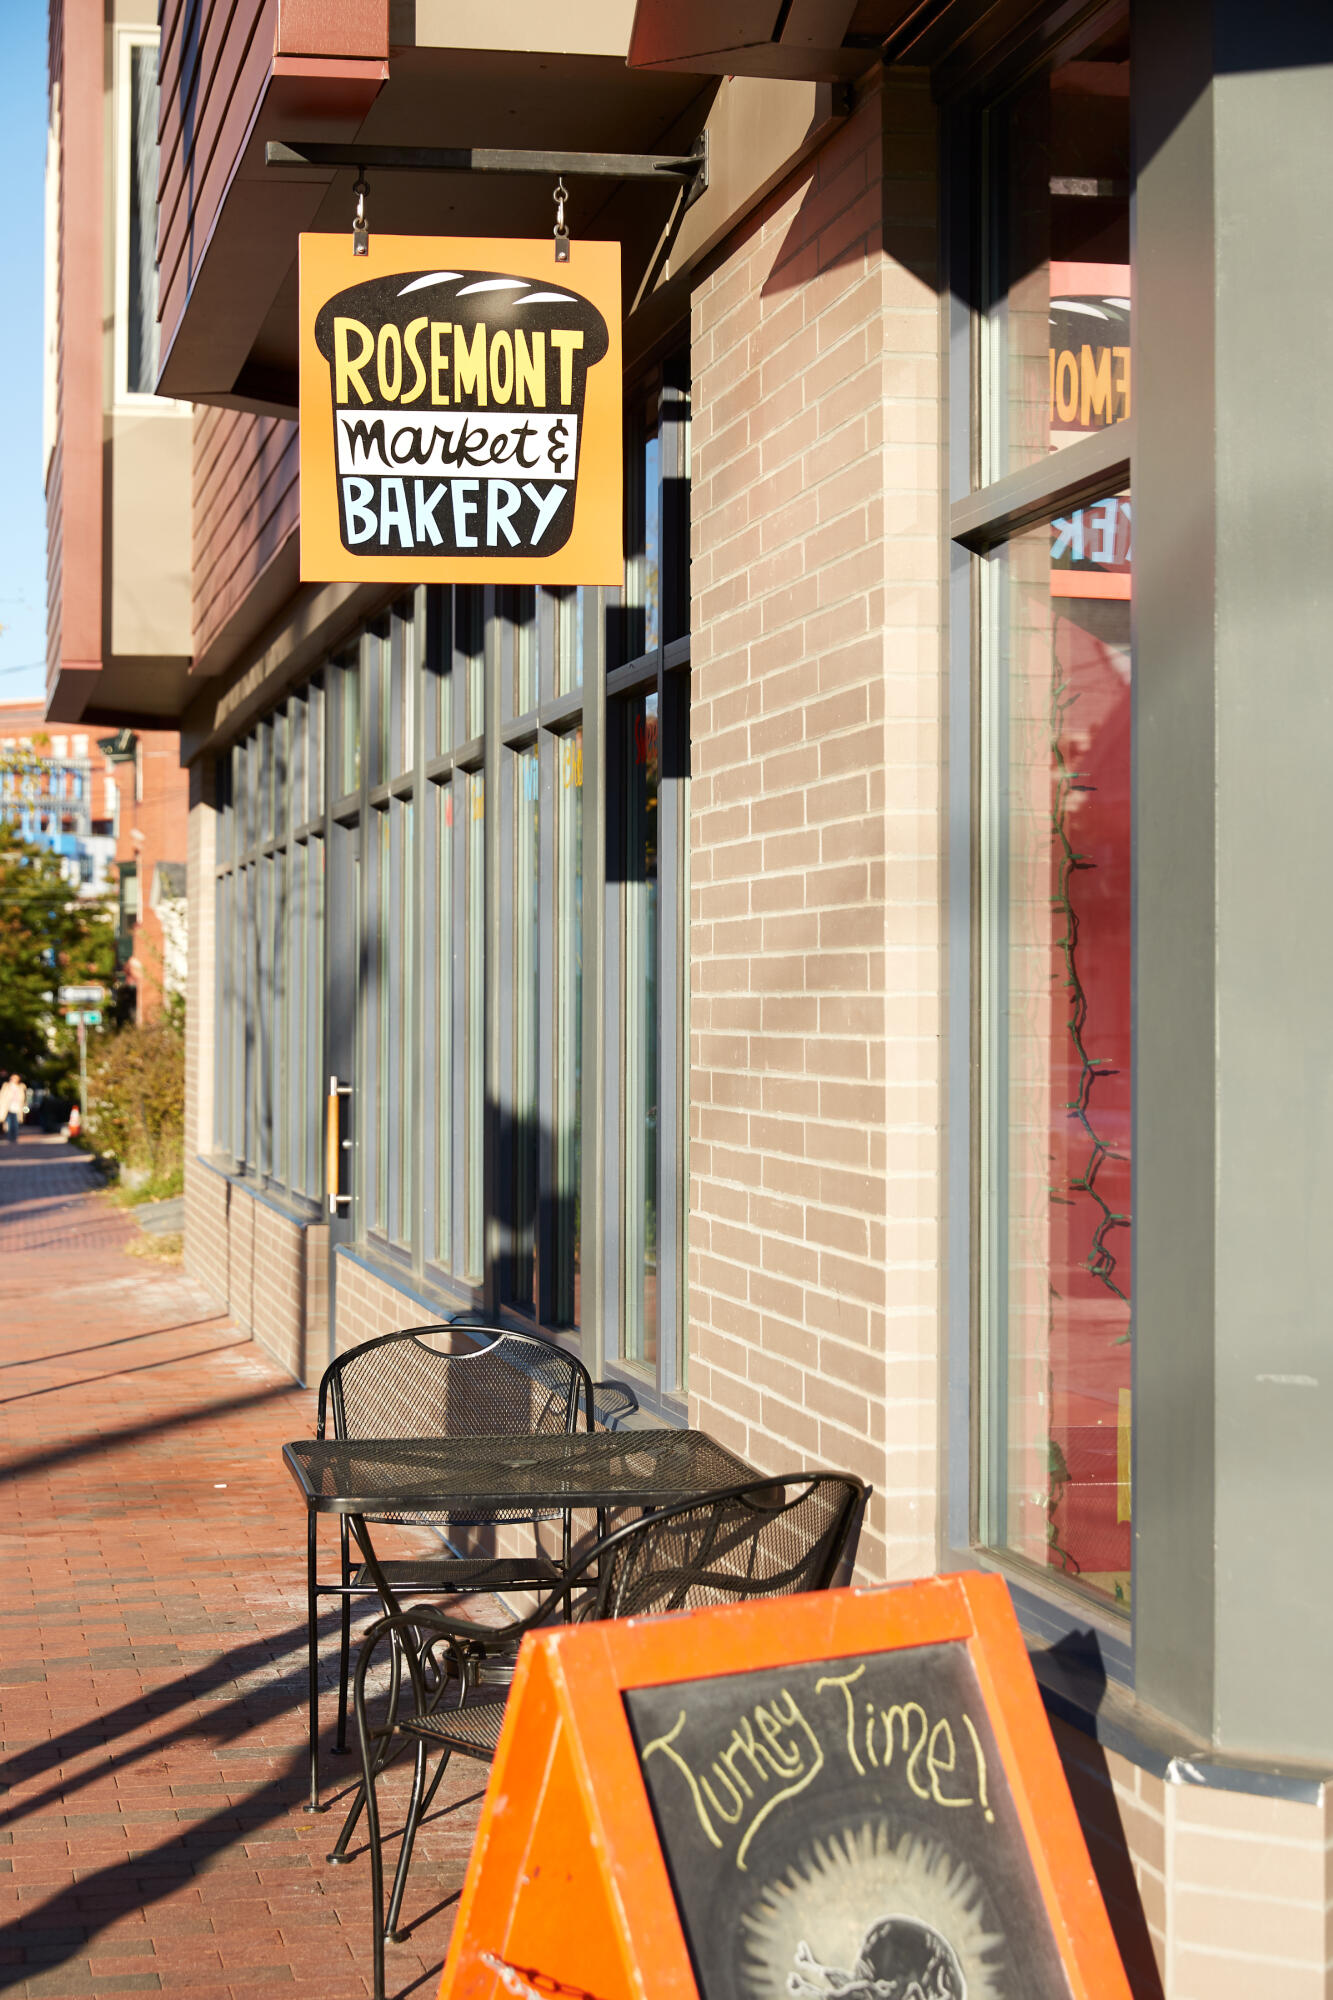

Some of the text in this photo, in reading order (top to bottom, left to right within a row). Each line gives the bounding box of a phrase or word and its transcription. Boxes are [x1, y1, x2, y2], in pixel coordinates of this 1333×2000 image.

[333, 316, 584, 407] ROSEMONT
[547, 419, 570, 473] &
[342, 477, 568, 548] BAKERY
[642, 1663, 995, 1871] Turkey Time!
